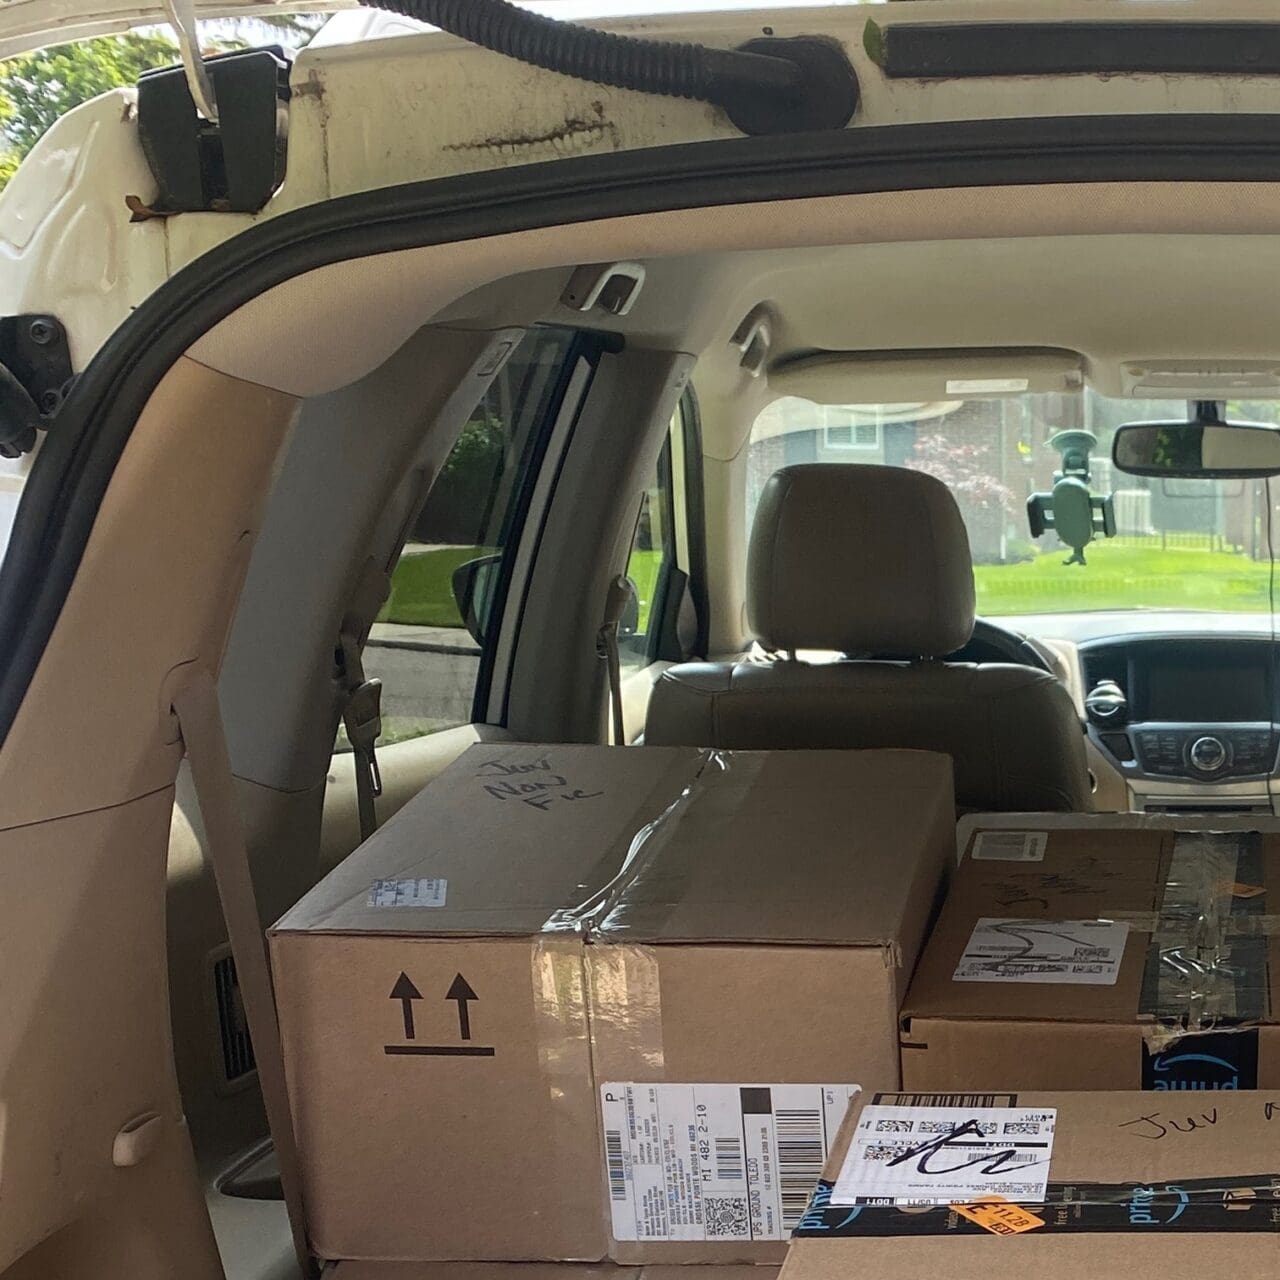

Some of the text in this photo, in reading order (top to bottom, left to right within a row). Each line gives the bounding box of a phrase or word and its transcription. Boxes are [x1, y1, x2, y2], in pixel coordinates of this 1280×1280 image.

[605, 1092, 618, 1101] P
[695, 1104, 712, 1181] MI 482 2-10
[747, 1157, 763, 1235] UPS GROUND TOLEDO
